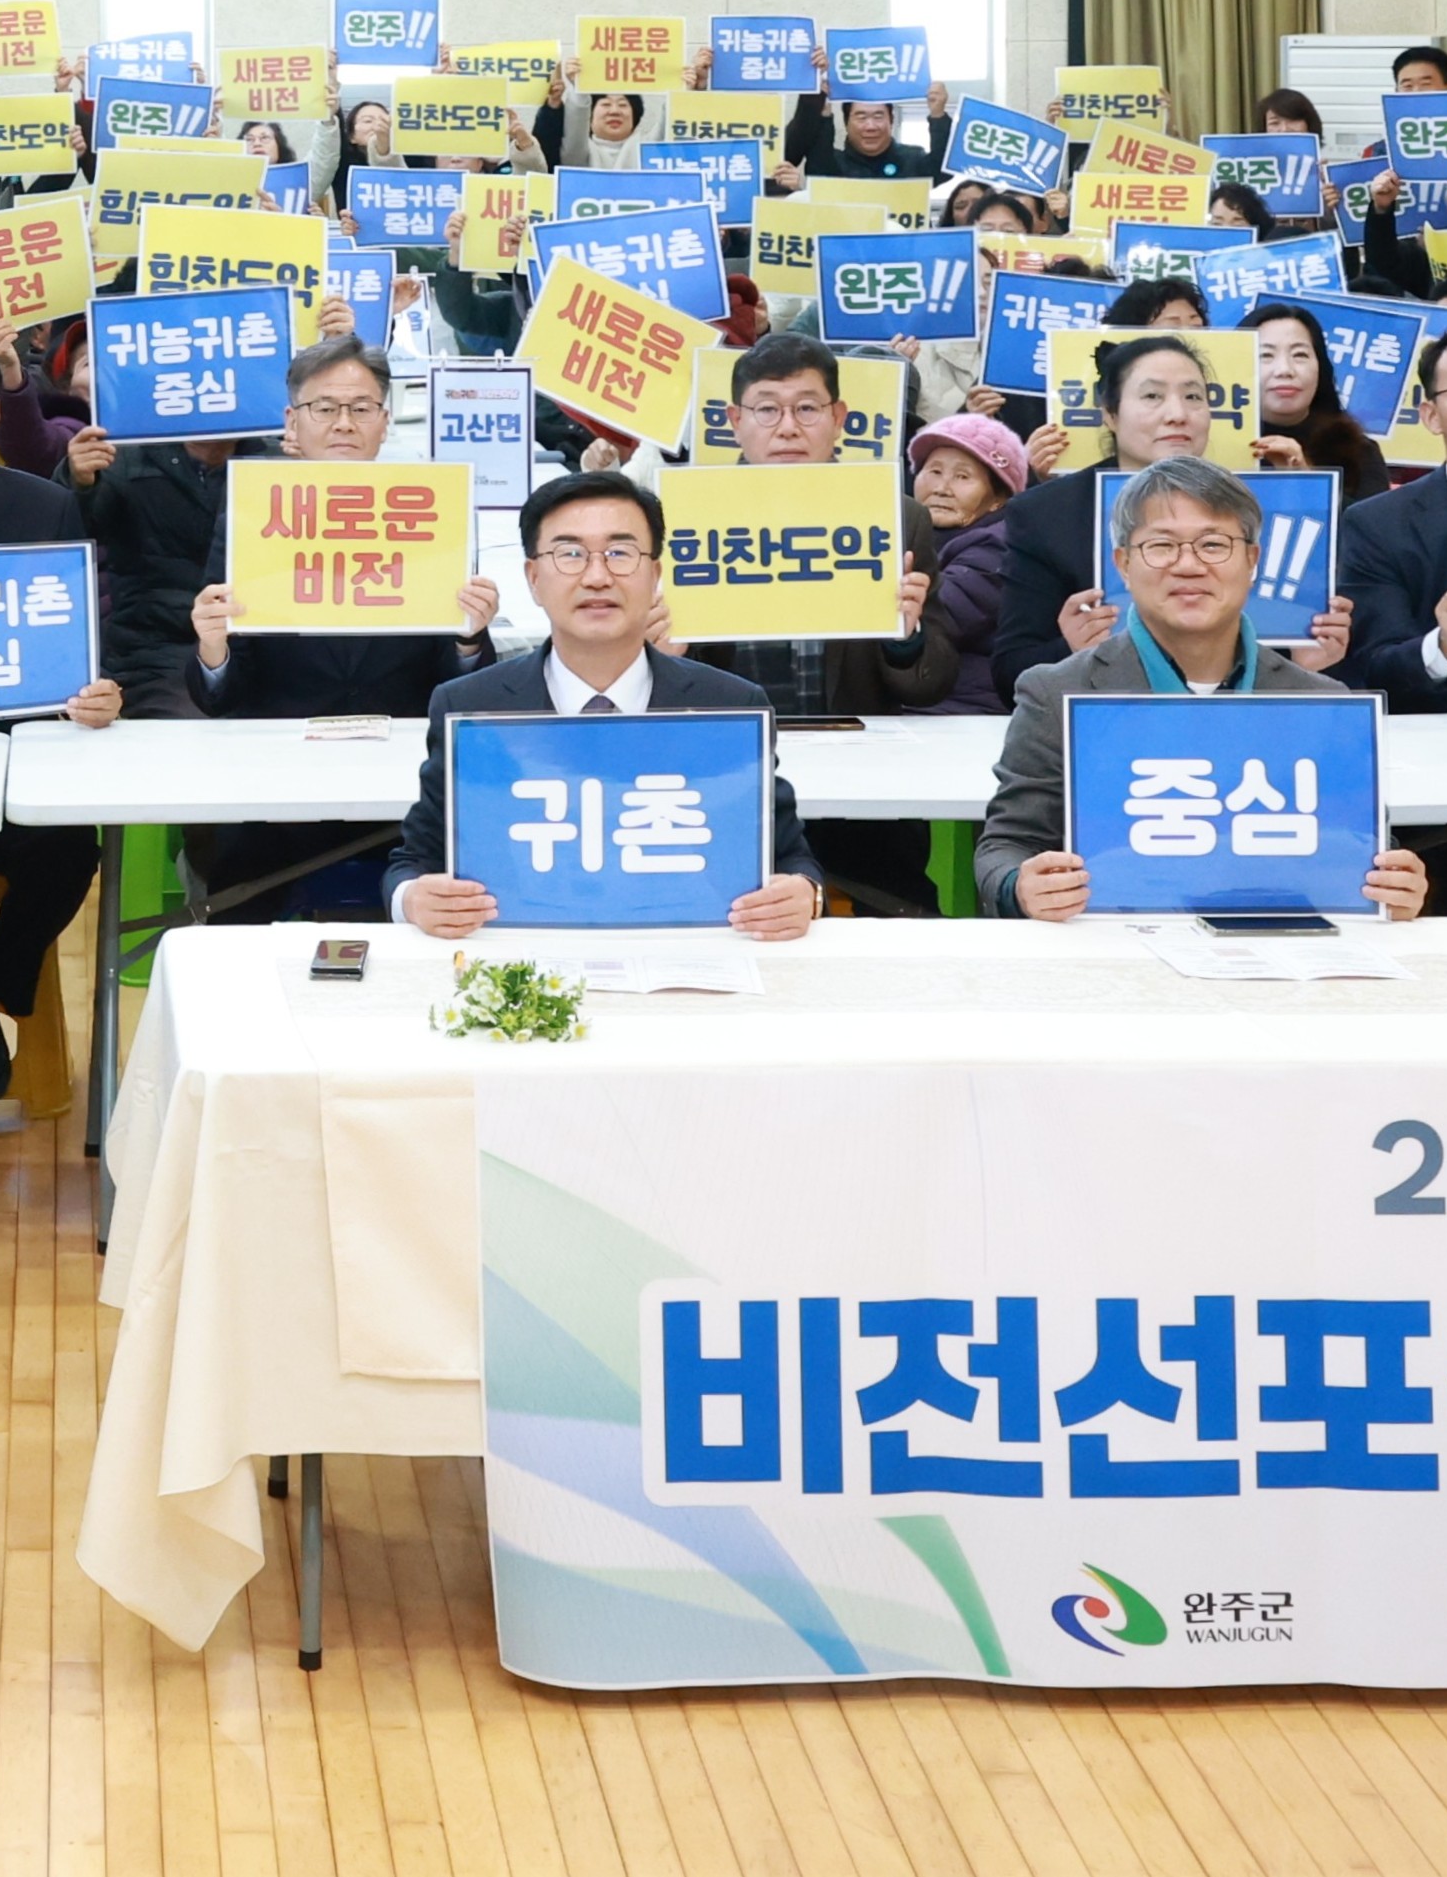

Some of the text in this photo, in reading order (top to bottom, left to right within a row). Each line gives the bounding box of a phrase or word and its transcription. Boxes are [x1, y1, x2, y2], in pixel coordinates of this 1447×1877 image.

[344, 10, 436, 48] 완주!!
[590, 25, 671, 54] 새로운
[717, 28, 812, 55] 귀농귀촌
[94, 40, 188, 63] 귀농귀촌
[739, 55, 788, 82] 중심
[836, 44, 927, 82] 완주!!
[232, 55, 313, 85] 새로운
[604, 56, 657, 84] 비전
[248, 85, 300, 114] 비전
[396, 102, 506, 132] 힘찬도약
[1061, 93, 1162, 120] 힘찬도약
[107, 99, 206, 138] 완주!!
[966, 120, 1059, 174] 완주!!
[356, 182, 460, 210] 귀농귀촌
[1090, 184, 1190, 212] 새로운
[383, 211, 435, 237] 중심
[837, 258, 975, 315] 완주!!
[1207, 252, 1332, 301] 귀농귀촌
[106, 311, 279, 367] 귀농귀촌
[557, 282, 686, 375] 새로운
[151, 367, 237, 417] 중심
[561, 339, 648, 414] 비전
[439, 411, 522, 443] 고산면
[259, 482, 439, 544] 새로운
[668, 525, 891, 586] 힘찬도약
[293, 550, 405, 608] 비전
[508, 772, 713, 874] 귀촌
[1122, 756, 1319, 859] 중심
[1182, 1590, 1295, 1625] 완주군
[1185, 1626, 1294, 1643] WANJUGUN
